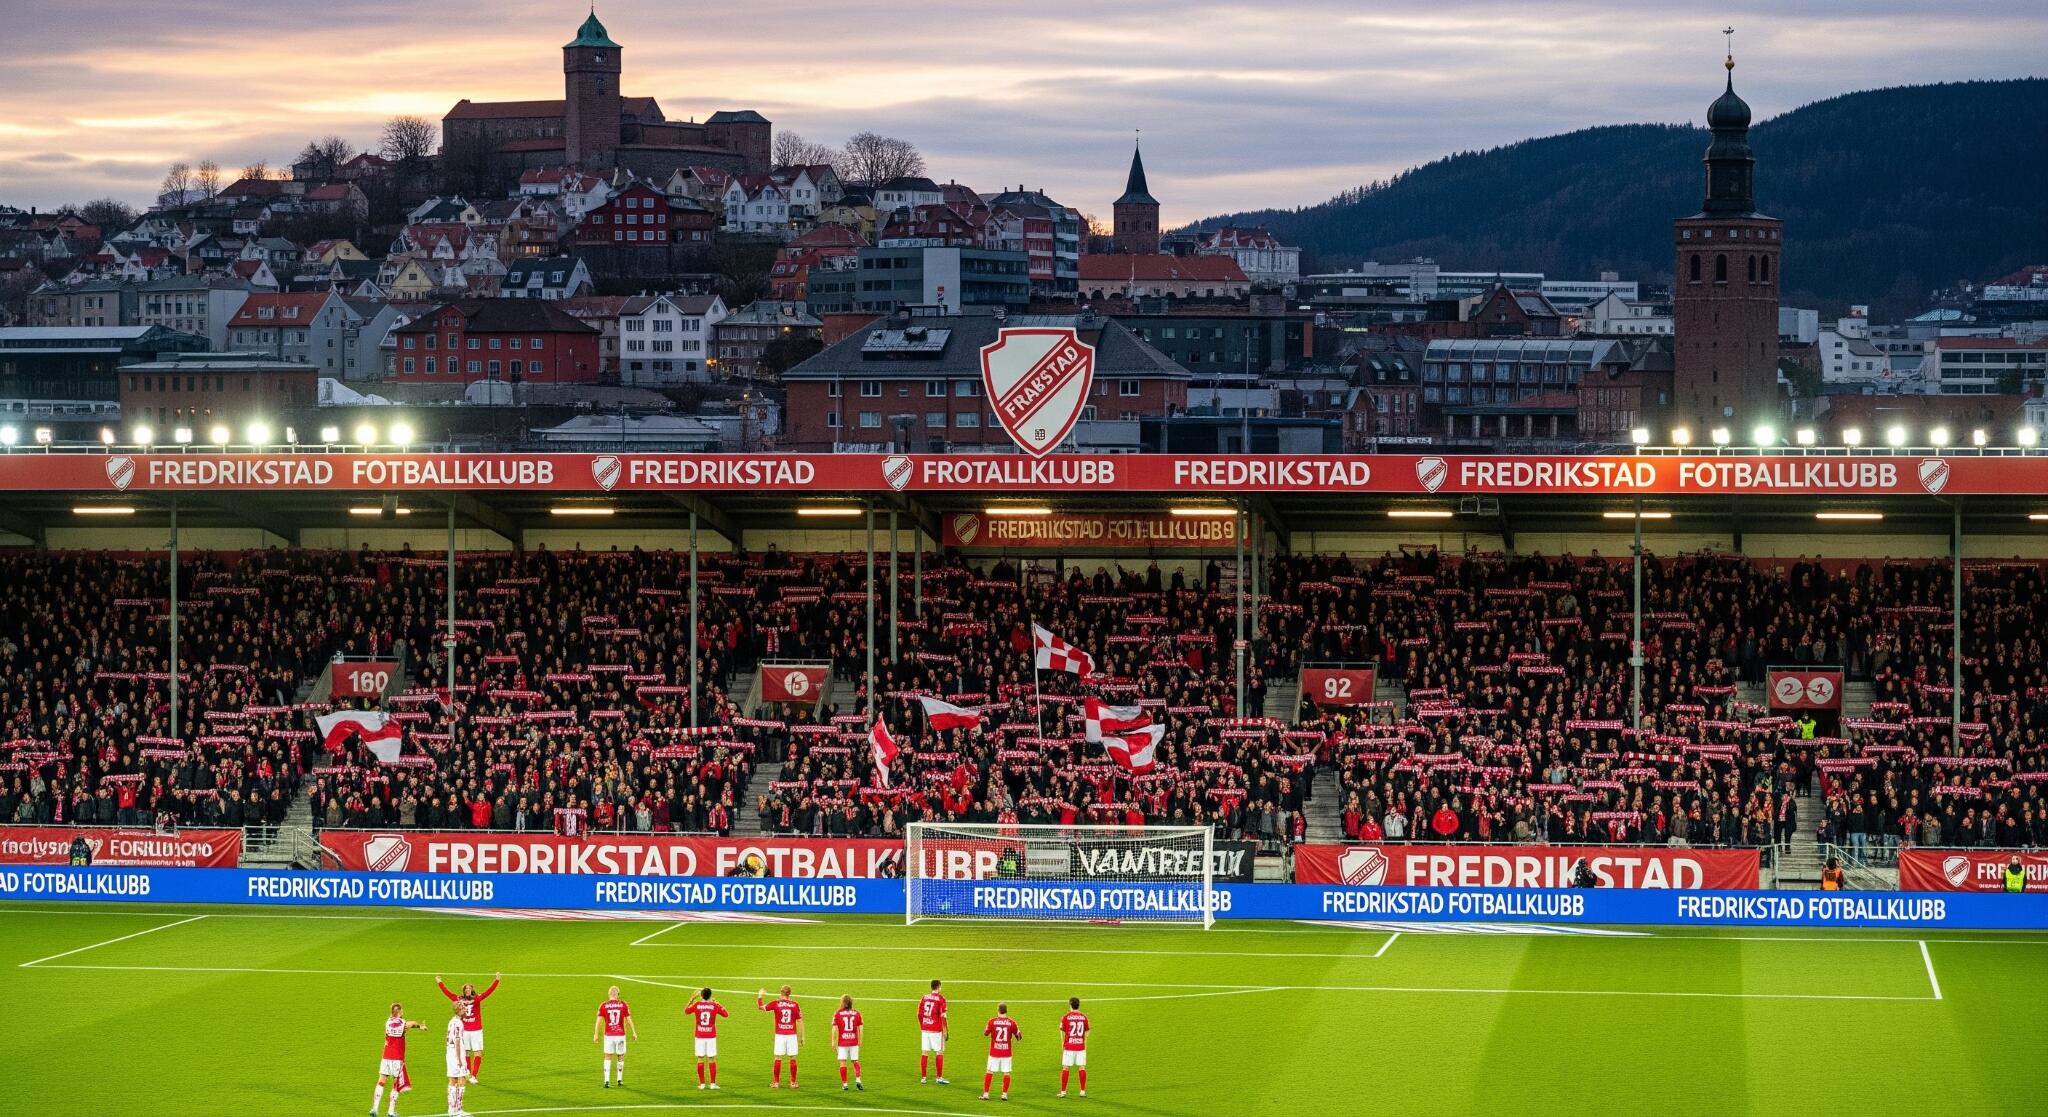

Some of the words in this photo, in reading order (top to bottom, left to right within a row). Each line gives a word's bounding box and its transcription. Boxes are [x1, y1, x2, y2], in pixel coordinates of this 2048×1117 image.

[149, 460, 333, 486] FREDRIKSTAD
[352, 460, 554, 486] FOTBALLKLUBB
[630, 461, 815, 486] FREDRIKSTAD
[923, 460, 1115, 485] FROTALLKLUBB
[1174, 461, 1371, 486] FREDRIKSTAD
[1460, 461, 1656, 487] FREDRIKSTAD
[1679, 463, 1898, 488] FOTBALLKLUBB
[348, 670, 389, 693] 160
[1324, 677, 1352, 699] 92
[428, 842, 697, 877] FREDRIKSTAD
[23, 872, 151, 895] FOTBALLKLUBB
[1405, 855, 1704, 890] FREDRIKSTAD
[248, 876, 364, 900] FREDRIKSTAD
[368, 878, 494, 901] FOTBALLKLUBB
[595, 881, 717, 905] FREDRIKSTAD
[721, 884, 857, 907] FOTBALLKLUBB
[973, 887, 1096, 911] FREDRIKSTAD
[1100, 889, 1232, 912] FOTBALLKLUBB
[1323, 891, 1444, 914] FREDRIKSTAD
[1448, 892, 1585, 917] FOTBALLKLUBB
[1678, 895, 1805, 919] FREDRIKSTAD
[1808, 897, 1946, 921] FOTBALLKLUBB
[995, 1026, 1008, 1042] 21
